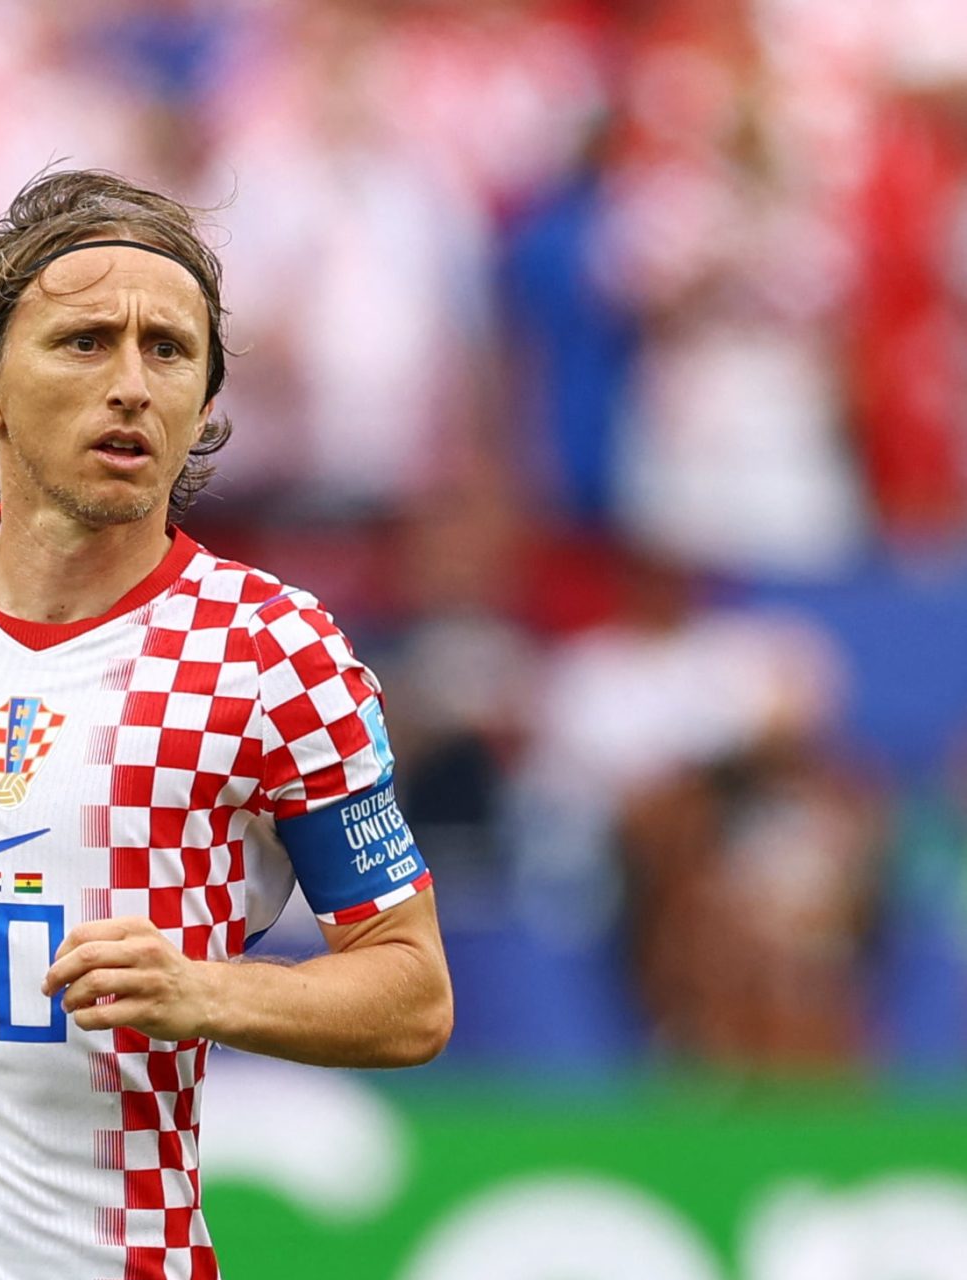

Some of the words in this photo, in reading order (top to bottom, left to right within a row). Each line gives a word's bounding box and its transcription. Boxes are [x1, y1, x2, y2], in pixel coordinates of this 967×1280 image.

[9, 704, 30, 762] HNS
[345, 801, 404, 850] UNITES
[350, 850, 386, 874] the
[391, 859, 415, 879] FIFA
